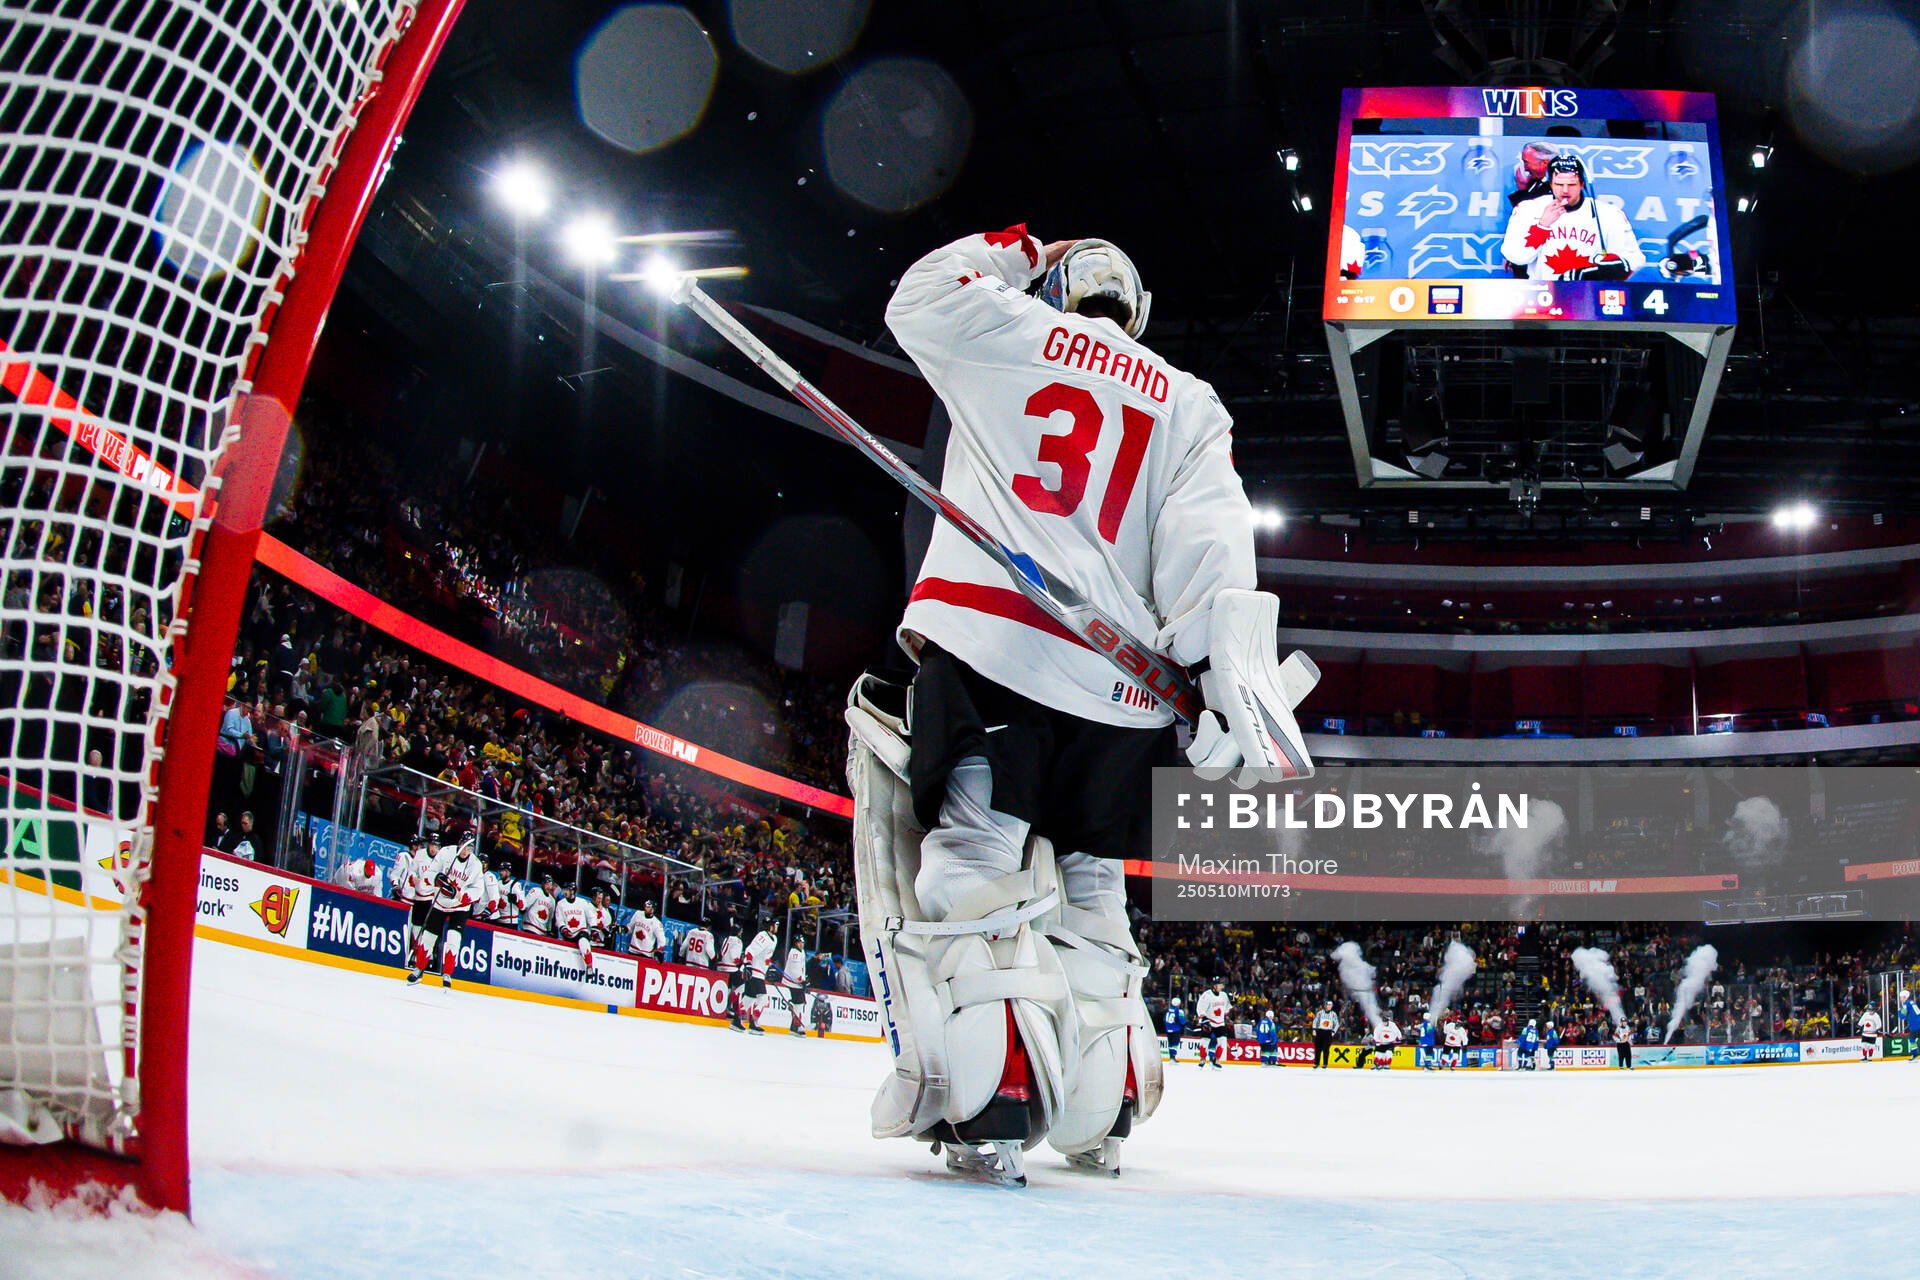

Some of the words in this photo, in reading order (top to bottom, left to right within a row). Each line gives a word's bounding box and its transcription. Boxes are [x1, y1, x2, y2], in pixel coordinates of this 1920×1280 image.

[1482, 89, 1578, 117] WINS
[1548, 226, 1597, 247] ANADA
[1389, 286, 1416, 313] 0
[1643, 289, 1669, 315] 4
[1043, 326, 1169, 403] GARAND
[864, 434, 900, 464] MACH
[1011, 381, 1155, 545] 31
[635, 724, 672, 754] POWER
[671, 739, 699, 763] PLAY
[200, 868, 239, 892] iness
[688, 937, 704, 954] 96
[875, 938, 901, 1058] TRUE
[849, 1008, 879, 1022] TISSOT
